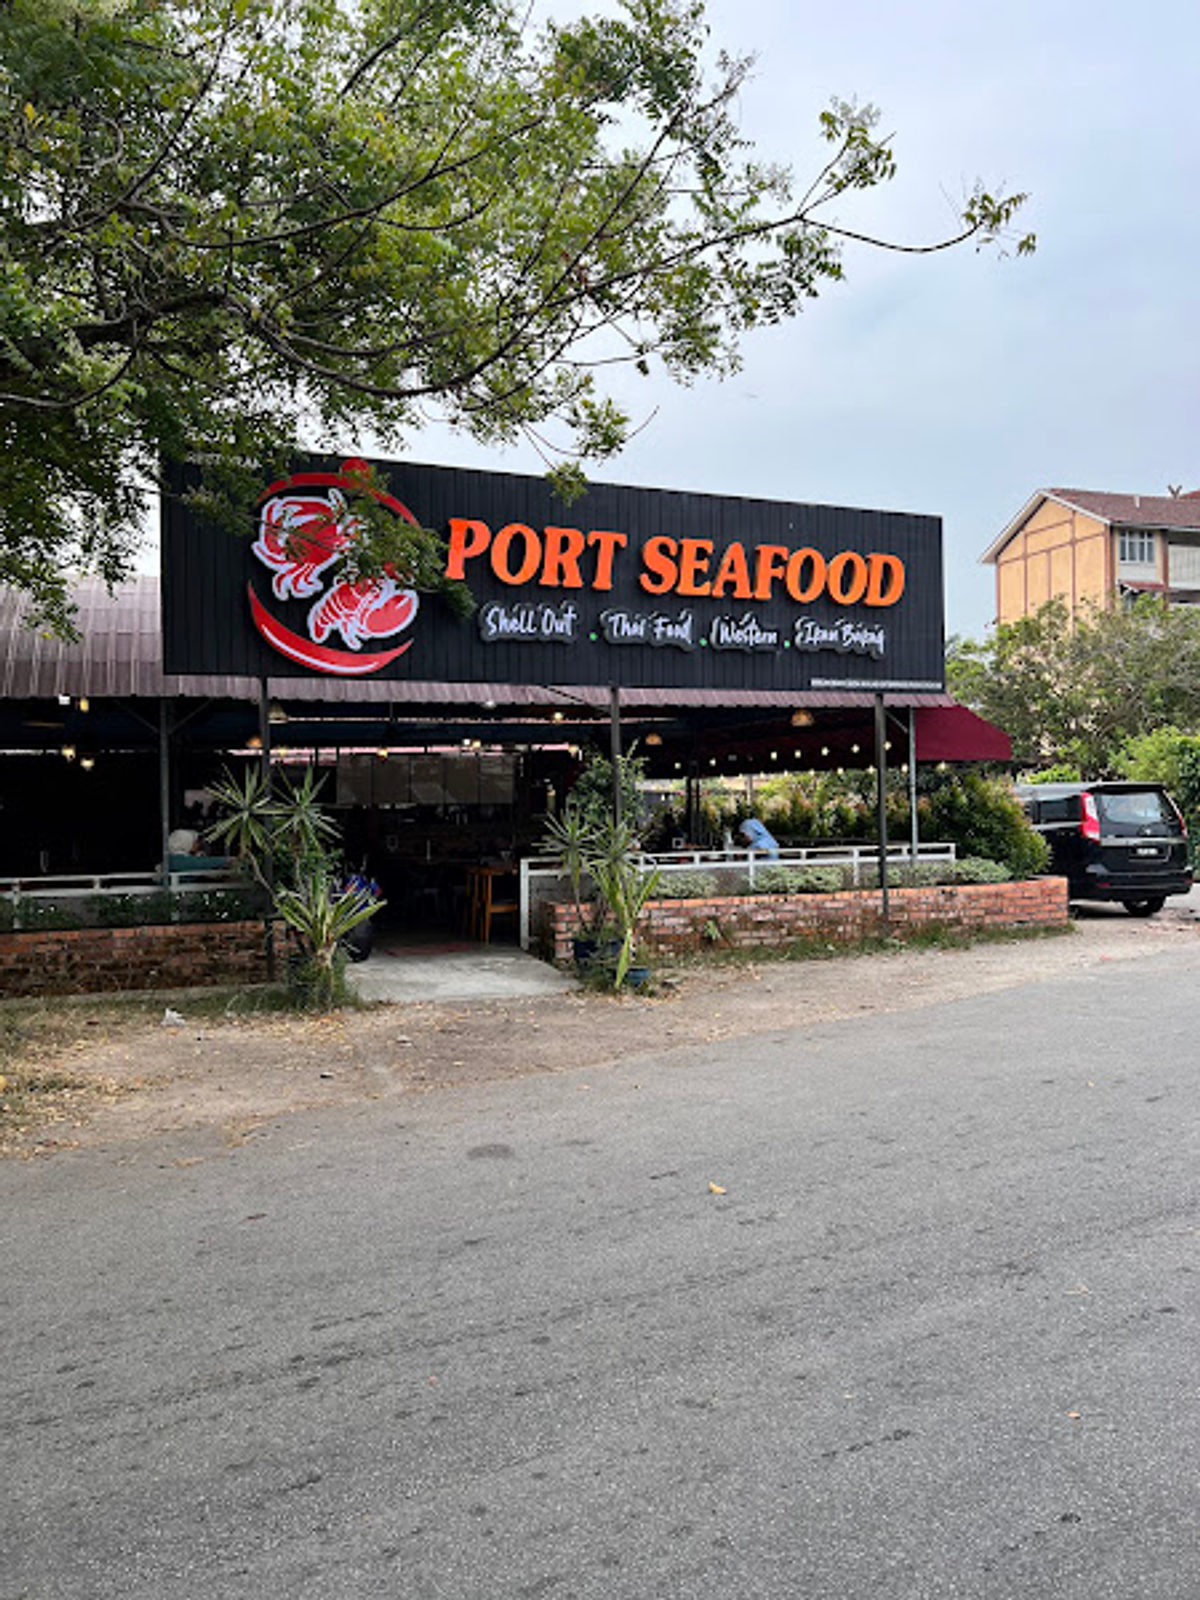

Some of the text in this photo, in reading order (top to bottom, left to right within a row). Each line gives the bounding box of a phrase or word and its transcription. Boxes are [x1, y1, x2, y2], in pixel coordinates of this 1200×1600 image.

[445, 518, 906, 607] PORT SEAFOOD
[541, 605, 577, 637] Out
[608, 612, 647, 638] Thai
[653, 612, 692, 644] Food
[719, 617, 778, 647] Western
